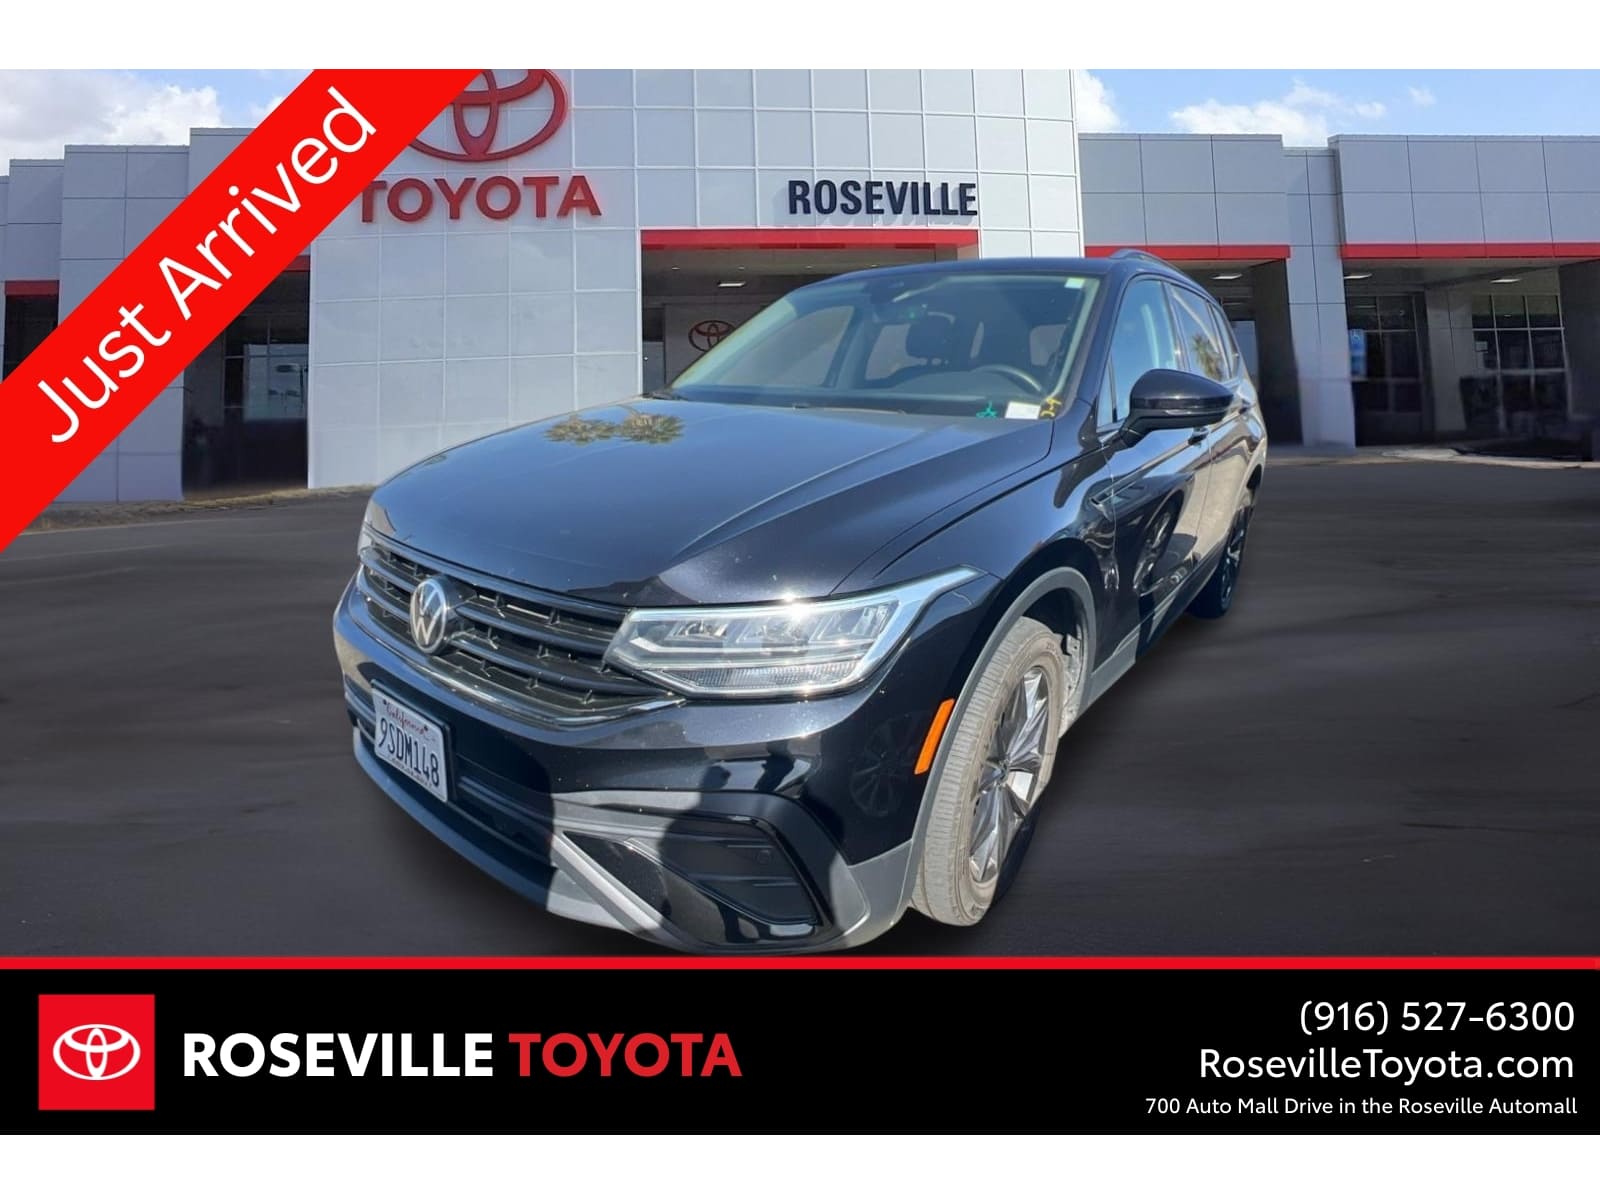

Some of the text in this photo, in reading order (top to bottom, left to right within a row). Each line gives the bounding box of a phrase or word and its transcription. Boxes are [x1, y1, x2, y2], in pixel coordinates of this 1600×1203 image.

[361, 175, 602, 223] TOYOTA
[788, 180, 978, 217] ROSEVILLE
[378, 717, 440, 787] 9SDM148
